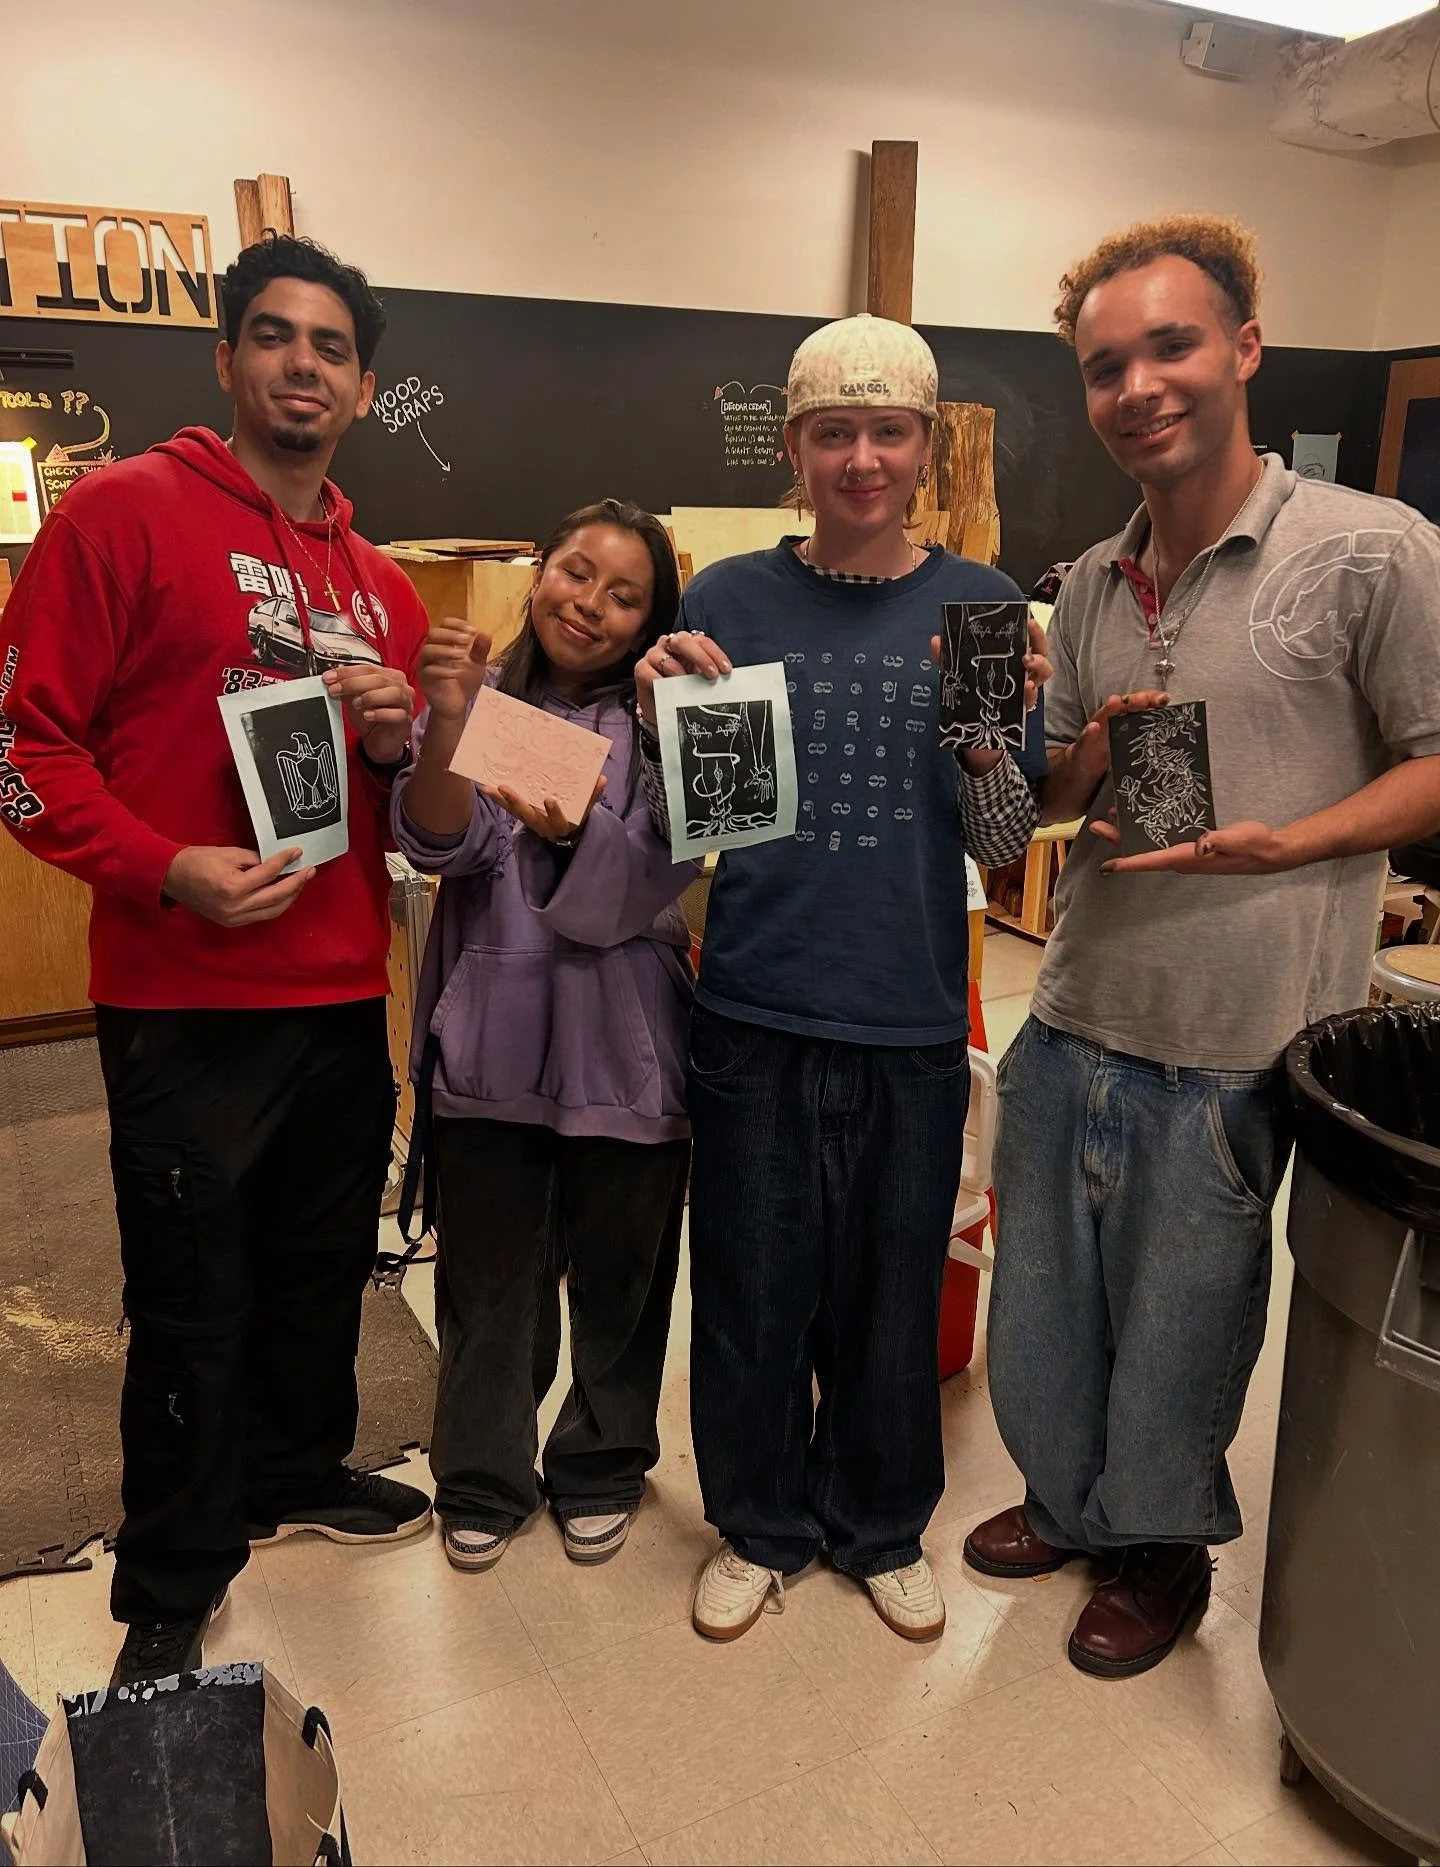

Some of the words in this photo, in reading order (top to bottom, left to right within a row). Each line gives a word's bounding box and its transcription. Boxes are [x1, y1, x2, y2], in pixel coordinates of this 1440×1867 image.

[371, 376, 421, 417] WOOD
[840, 382, 890, 395] KANGOL
[0, 391, 52, 409] TOOLS
[382, 385, 444, 433] SCRAPS
[43, 466, 78, 477] CHECK
